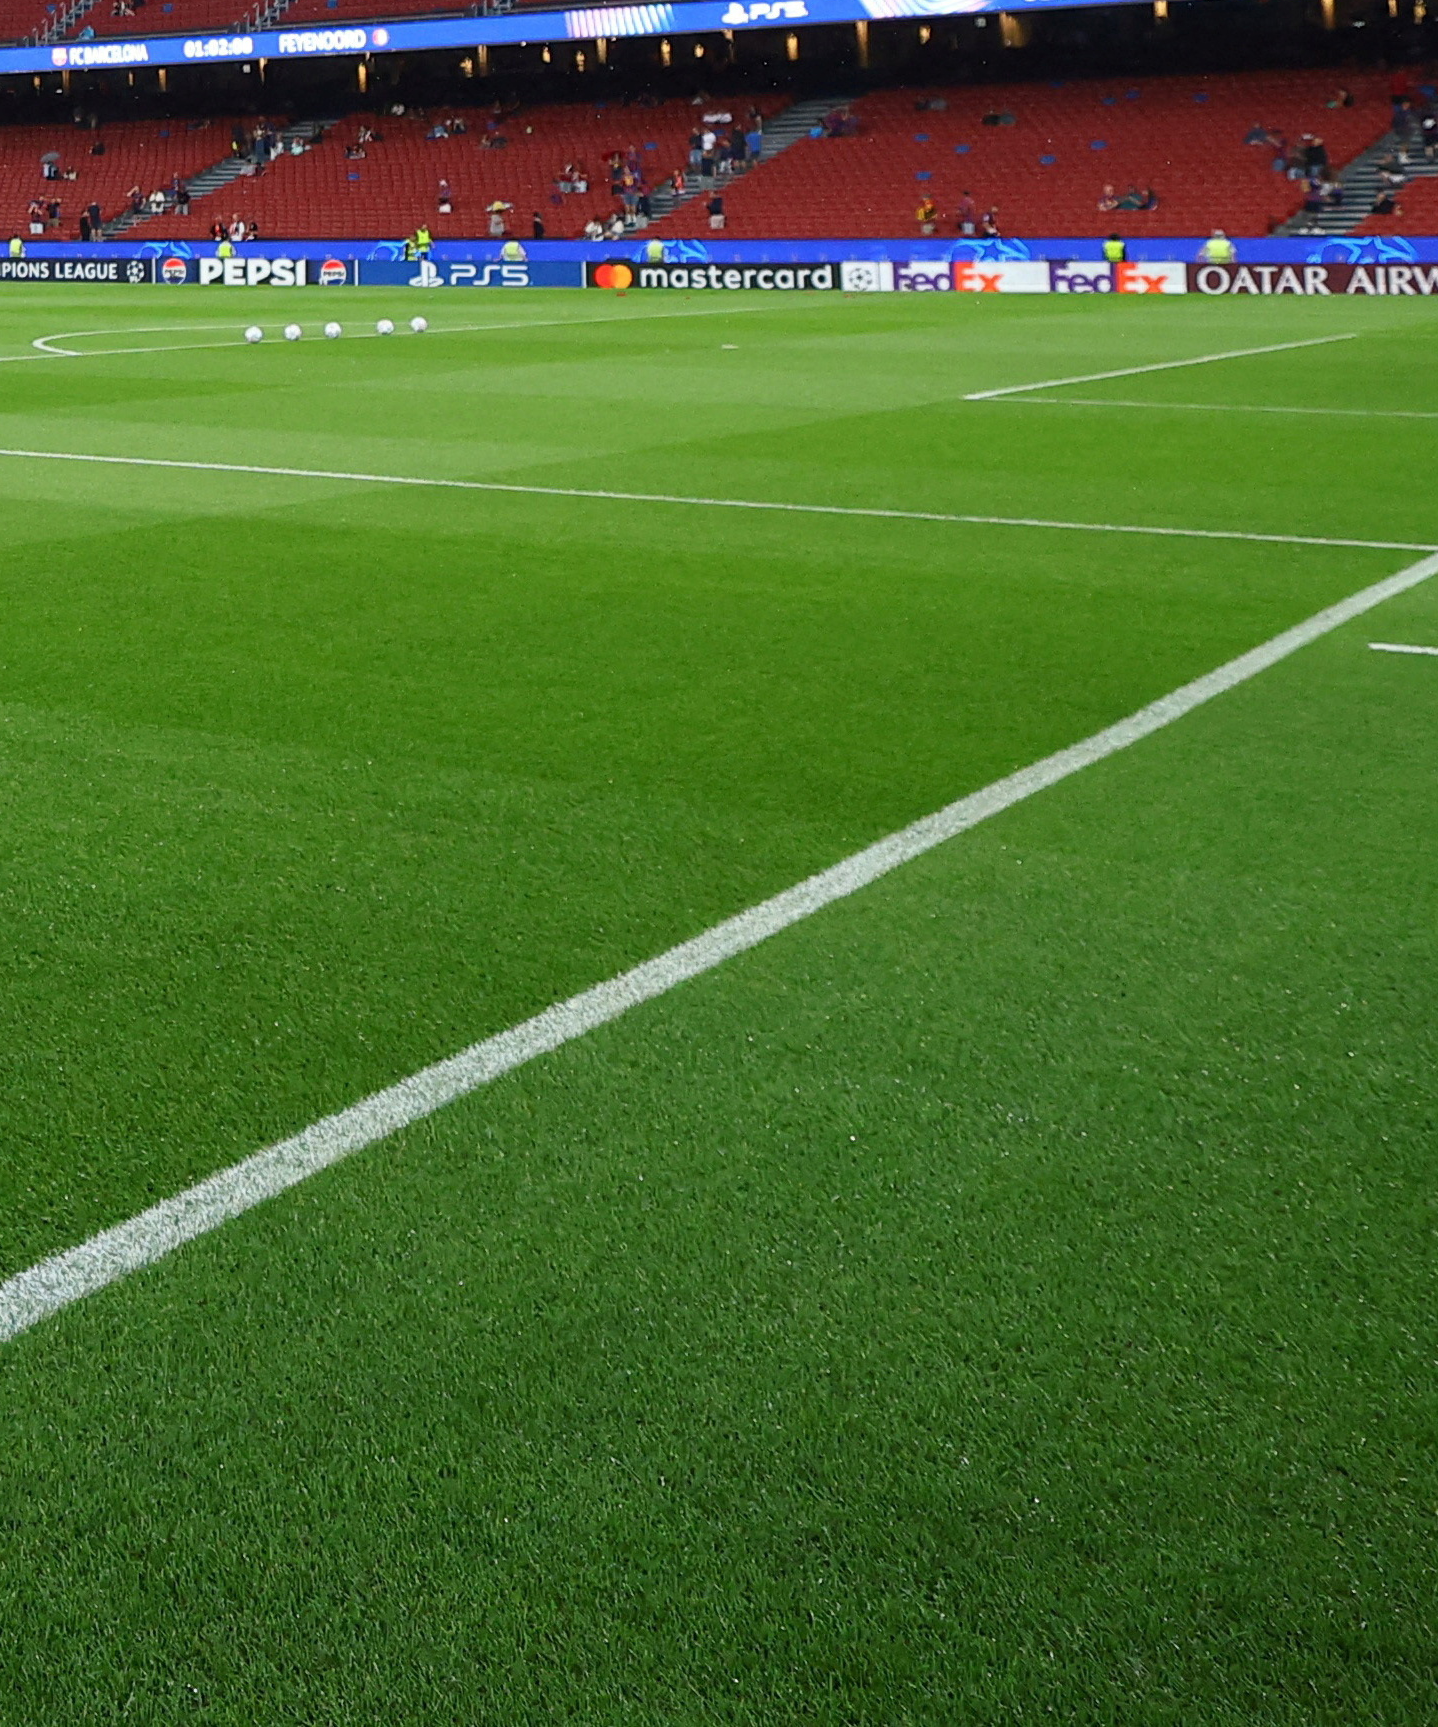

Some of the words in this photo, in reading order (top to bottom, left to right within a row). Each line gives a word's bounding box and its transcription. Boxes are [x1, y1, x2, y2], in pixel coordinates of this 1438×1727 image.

[279, 29, 366, 54] FEYENOORD
[55, 263, 118, 279] LEAGUE
[200, 258, 306, 286] PEPSI
[450, 264, 529, 286] PS5
[639, 264, 833, 289] mastercard
[894, 261, 1002, 292] FedEx
[1050, 261, 1167, 293] FedEx
[1197, 265, 1332, 295] QATAR
